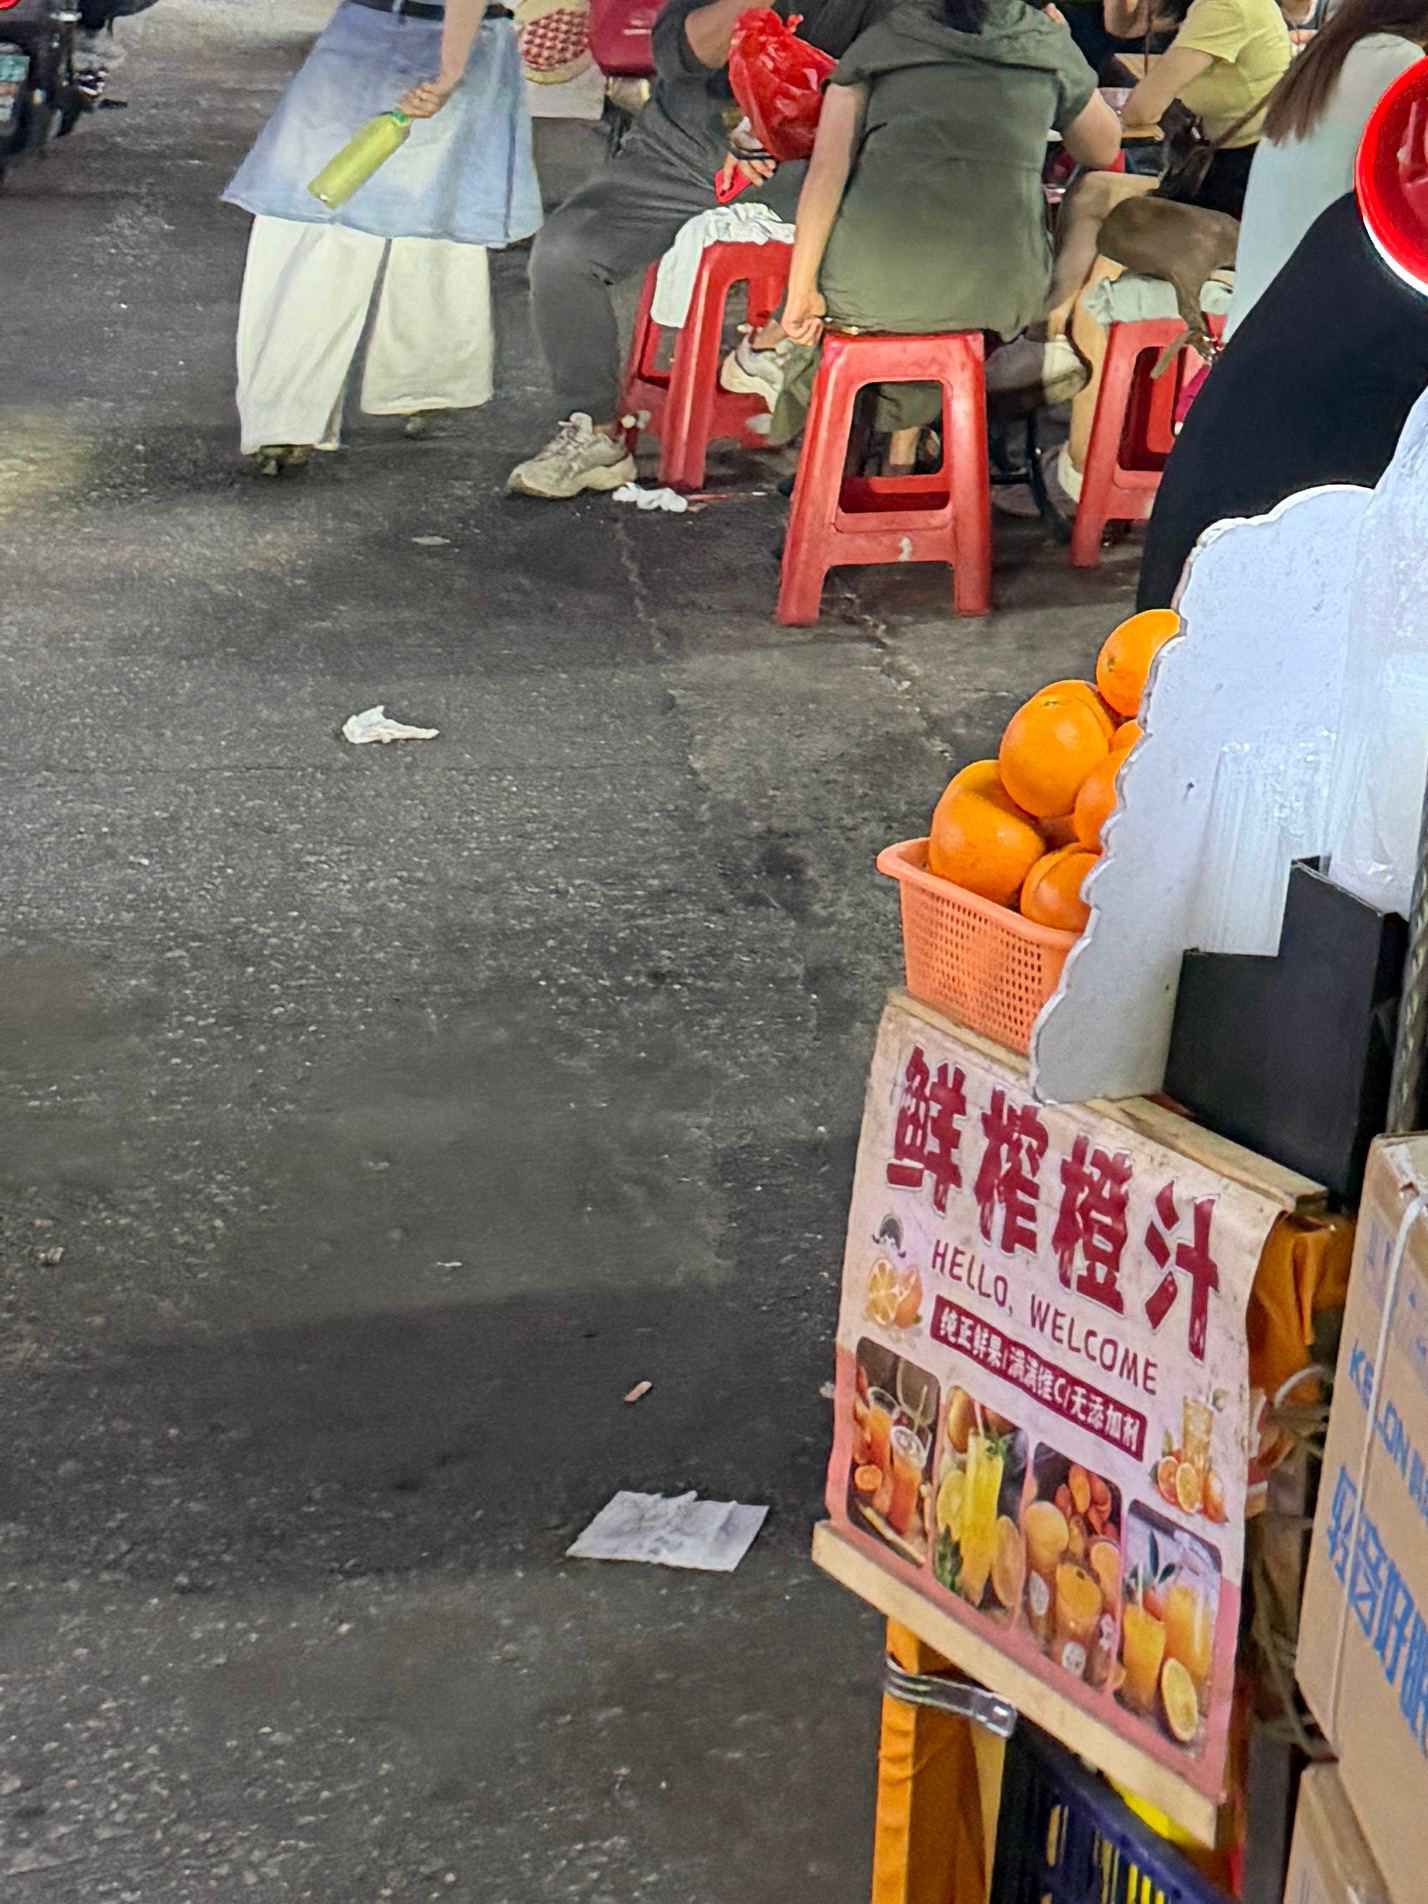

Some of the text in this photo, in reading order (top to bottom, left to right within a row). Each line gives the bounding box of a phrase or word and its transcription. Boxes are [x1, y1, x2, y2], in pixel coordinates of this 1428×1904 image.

[887, 1043, 1221, 1363] 鲜榨橙汁
[1030, 1294, 1158, 1396] WELCOME
